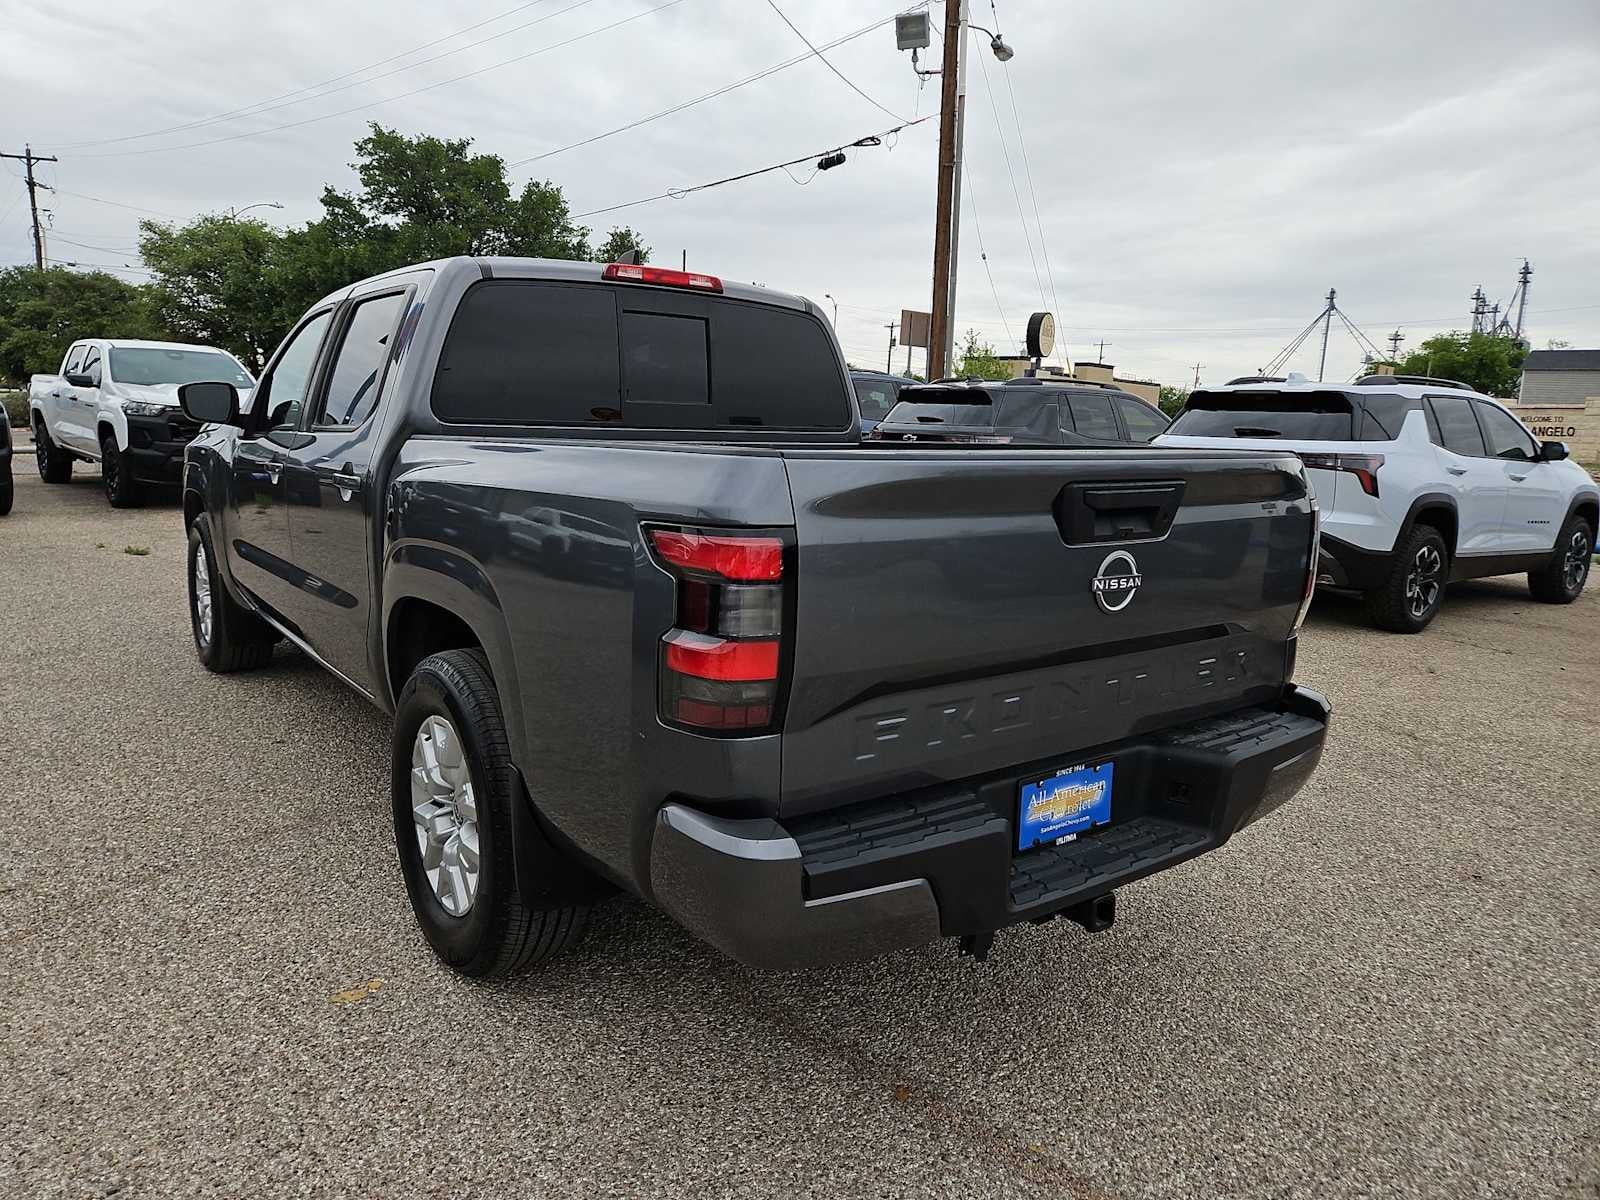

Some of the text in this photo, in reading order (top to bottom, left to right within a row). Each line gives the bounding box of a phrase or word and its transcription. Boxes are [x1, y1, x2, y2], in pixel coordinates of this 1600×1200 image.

[1531, 427, 1575, 436] ANGELO
[1094, 577, 1141, 590] NISSAN
[1056, 767, 1073, 777] SINCE
[1028, 780, 1105, 808] All American
[1040, 798, 1091, 822] Chevrolet
